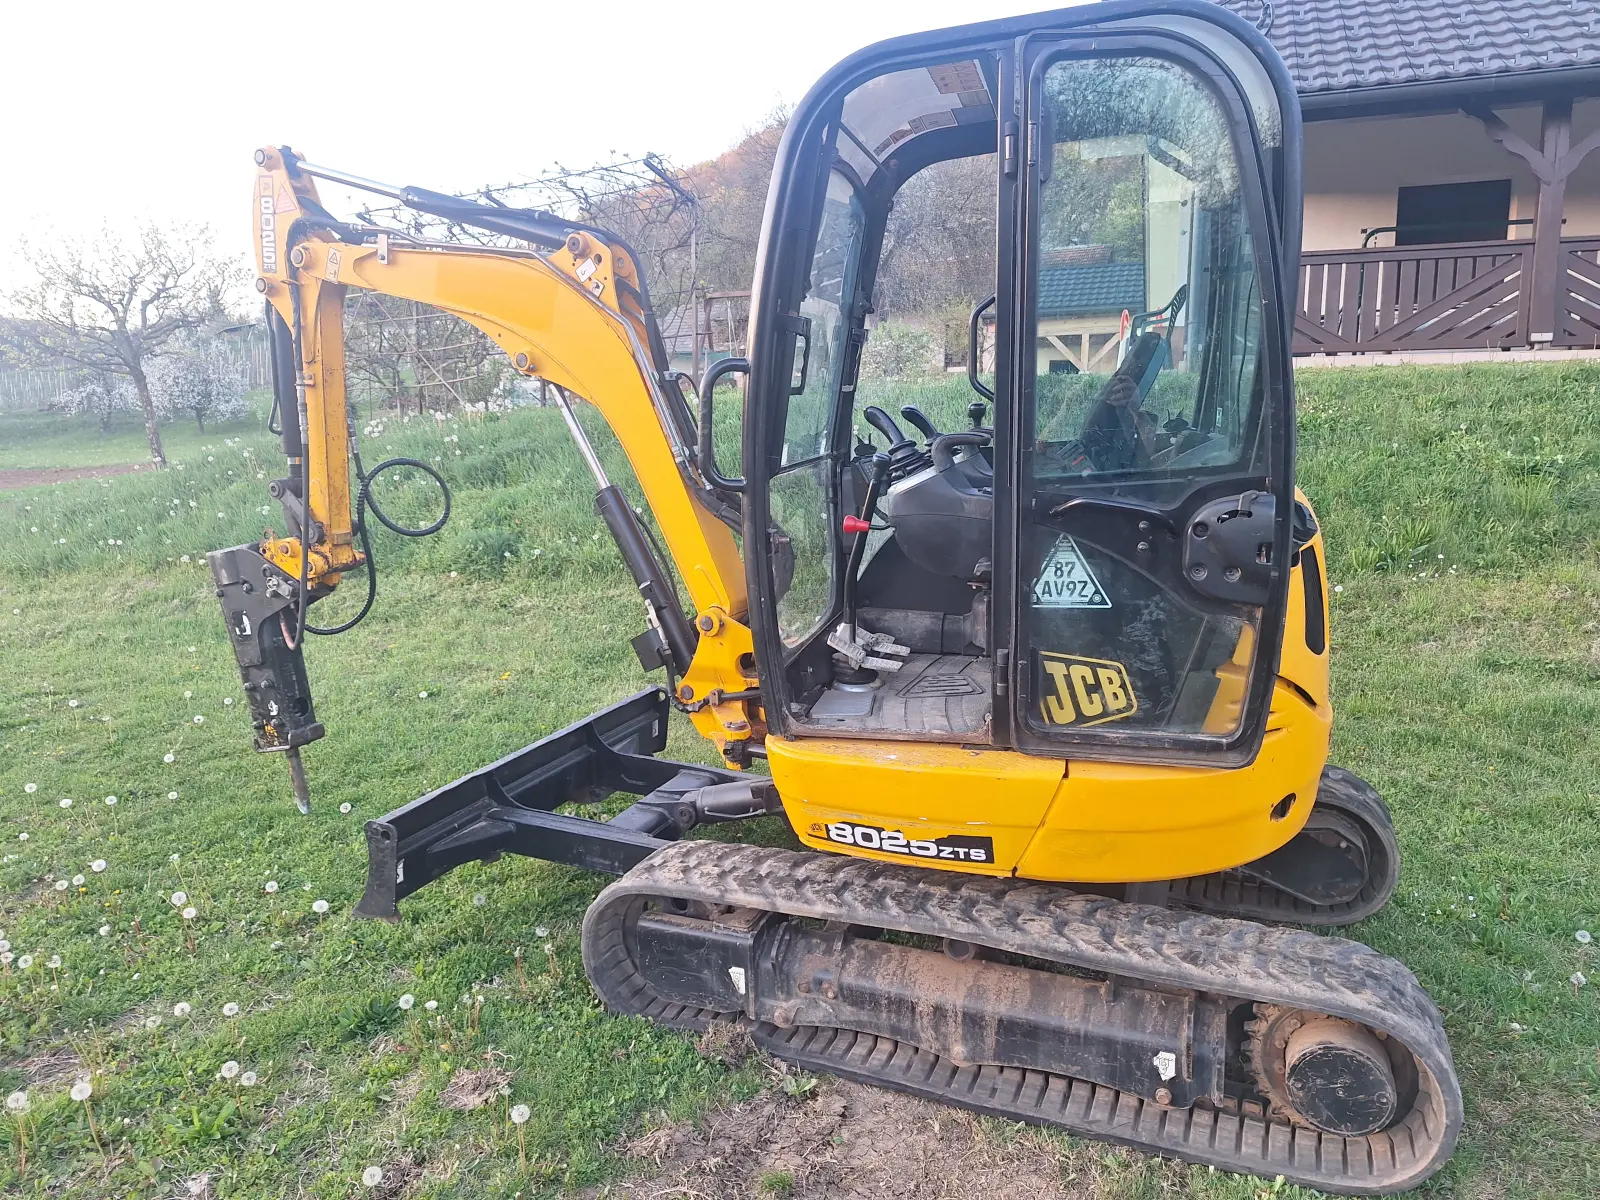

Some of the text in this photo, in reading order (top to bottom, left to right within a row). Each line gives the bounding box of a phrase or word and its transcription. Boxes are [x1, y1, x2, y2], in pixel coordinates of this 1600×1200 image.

[1054, 562, 1075, 579] 87
[1041, 581, 1088, 597] AV9Z
[1044, 661, 1127, 725] JCB
